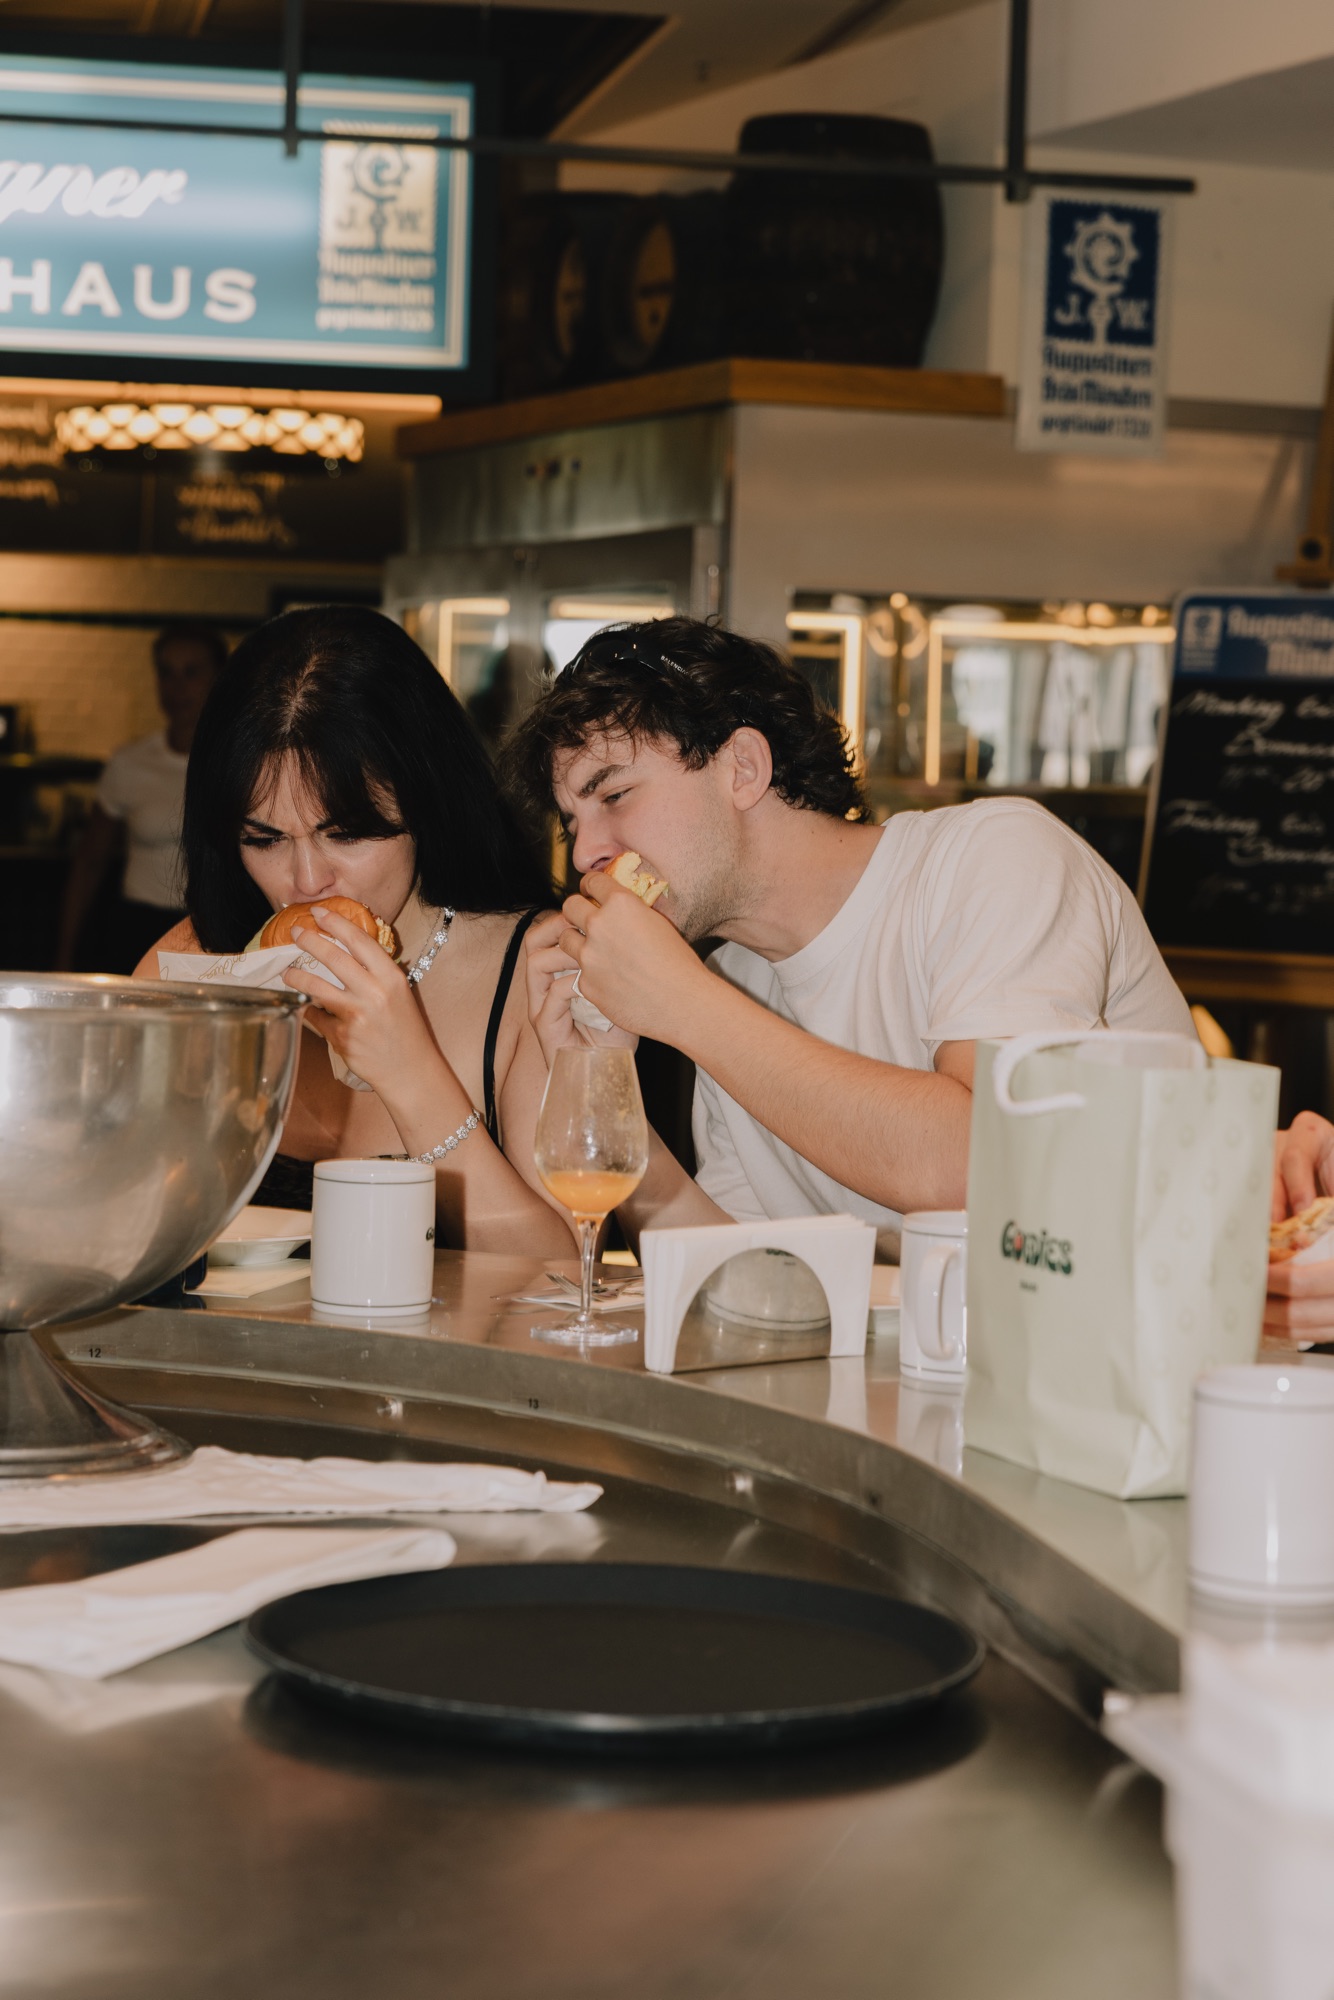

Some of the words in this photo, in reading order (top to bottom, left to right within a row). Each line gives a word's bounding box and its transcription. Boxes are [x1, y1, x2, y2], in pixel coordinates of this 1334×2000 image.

[0, 257, 257, 324] HAUS
[89, 1348, 101, 1359] 12
[528, 1398, 539, 1410] 13
